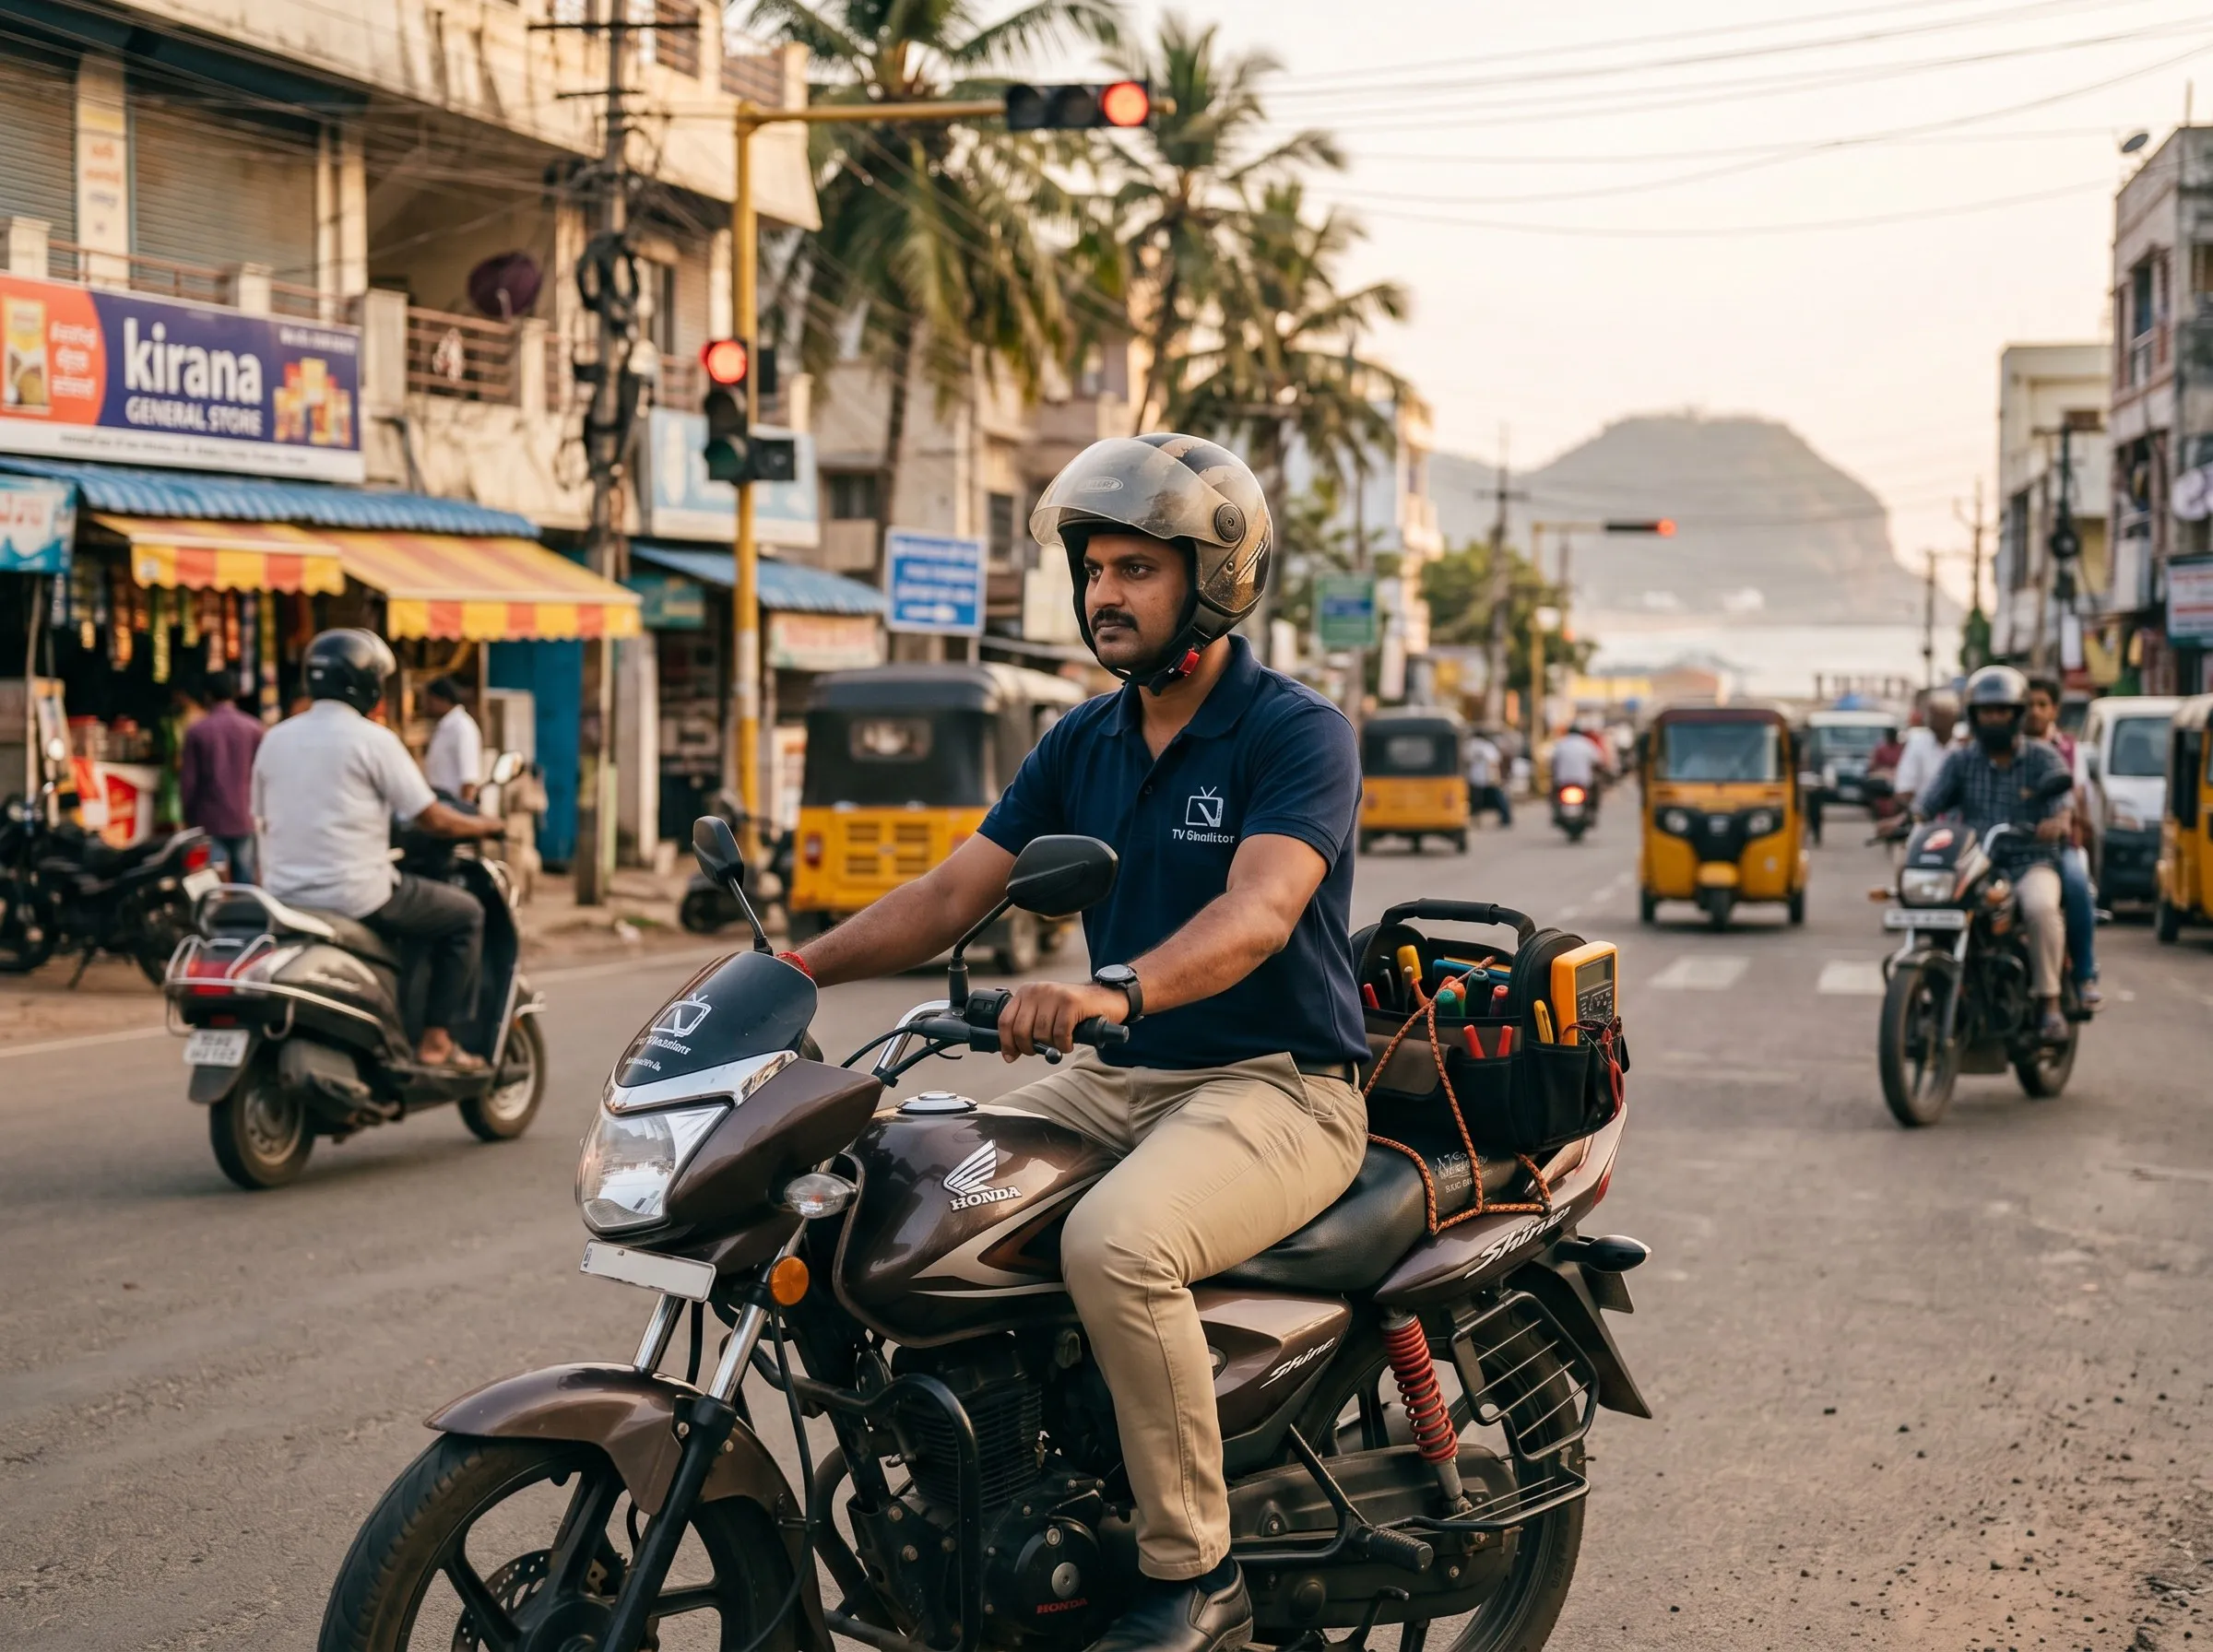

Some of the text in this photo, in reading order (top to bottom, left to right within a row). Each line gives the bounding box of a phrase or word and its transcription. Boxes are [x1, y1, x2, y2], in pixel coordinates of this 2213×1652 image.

[124, 317, 263, 403] kirana
[124, 395, 263, 438] GENERAL STORE
[1172, 829, 1186, 841] TV
[950, 1186, 1023, 1211] HONDA
[1035, 1598, 1088, 1614] HONDA
